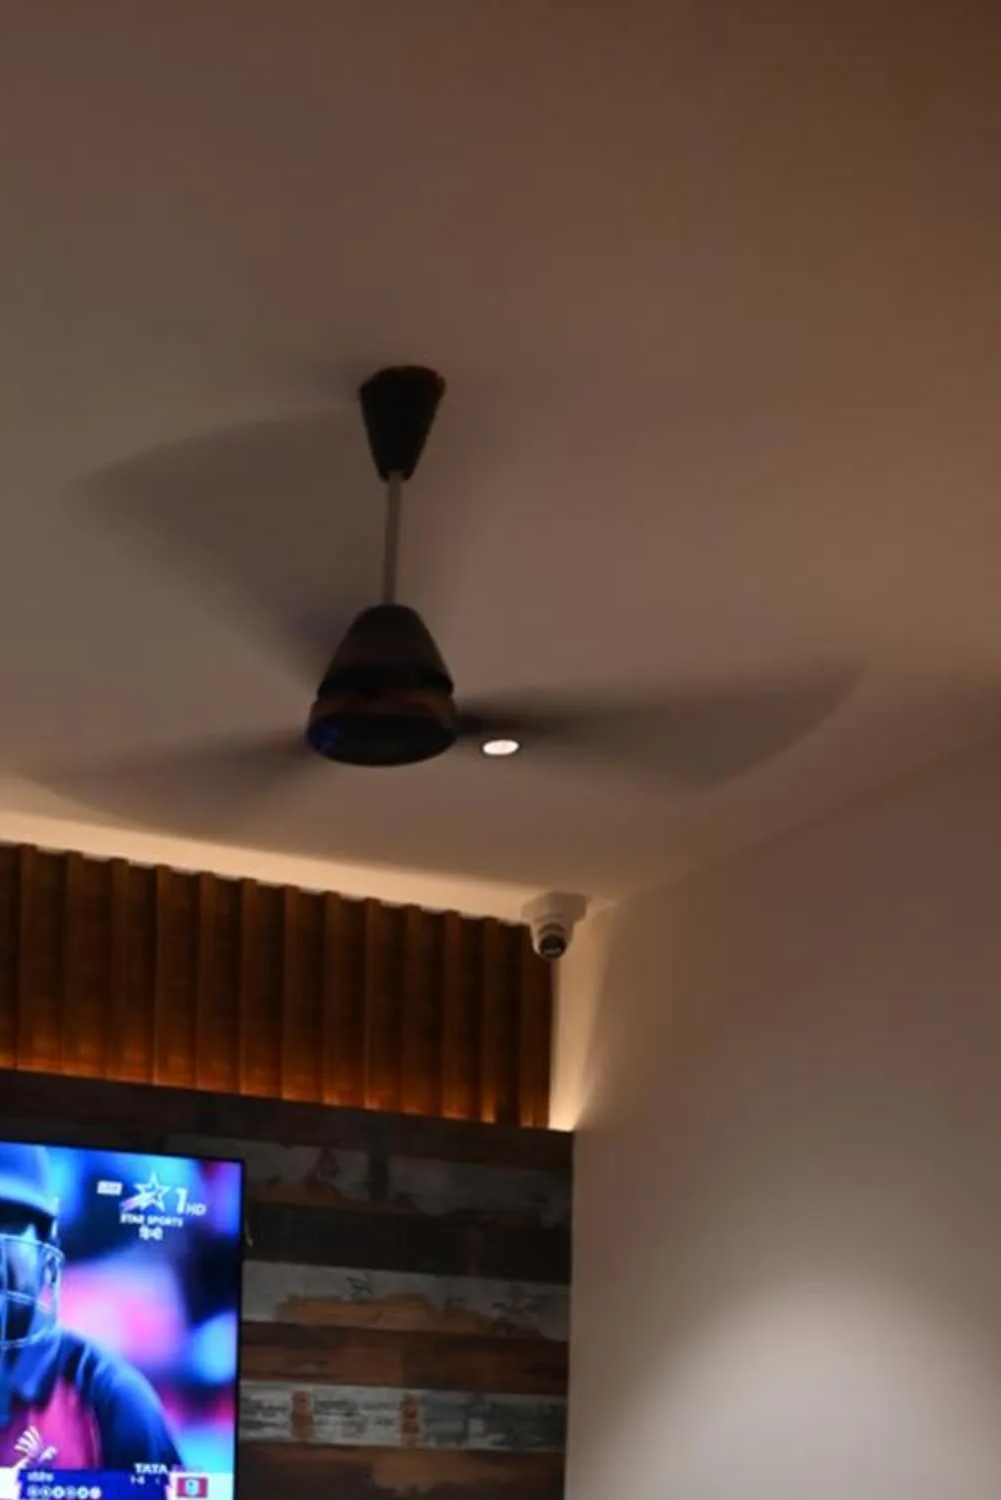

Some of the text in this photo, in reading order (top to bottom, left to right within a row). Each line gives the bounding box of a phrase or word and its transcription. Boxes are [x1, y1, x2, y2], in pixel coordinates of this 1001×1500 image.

[120, 1213, 183, 1227] STAR SPORTS
[134, 1463, 168, 1474] TATA
